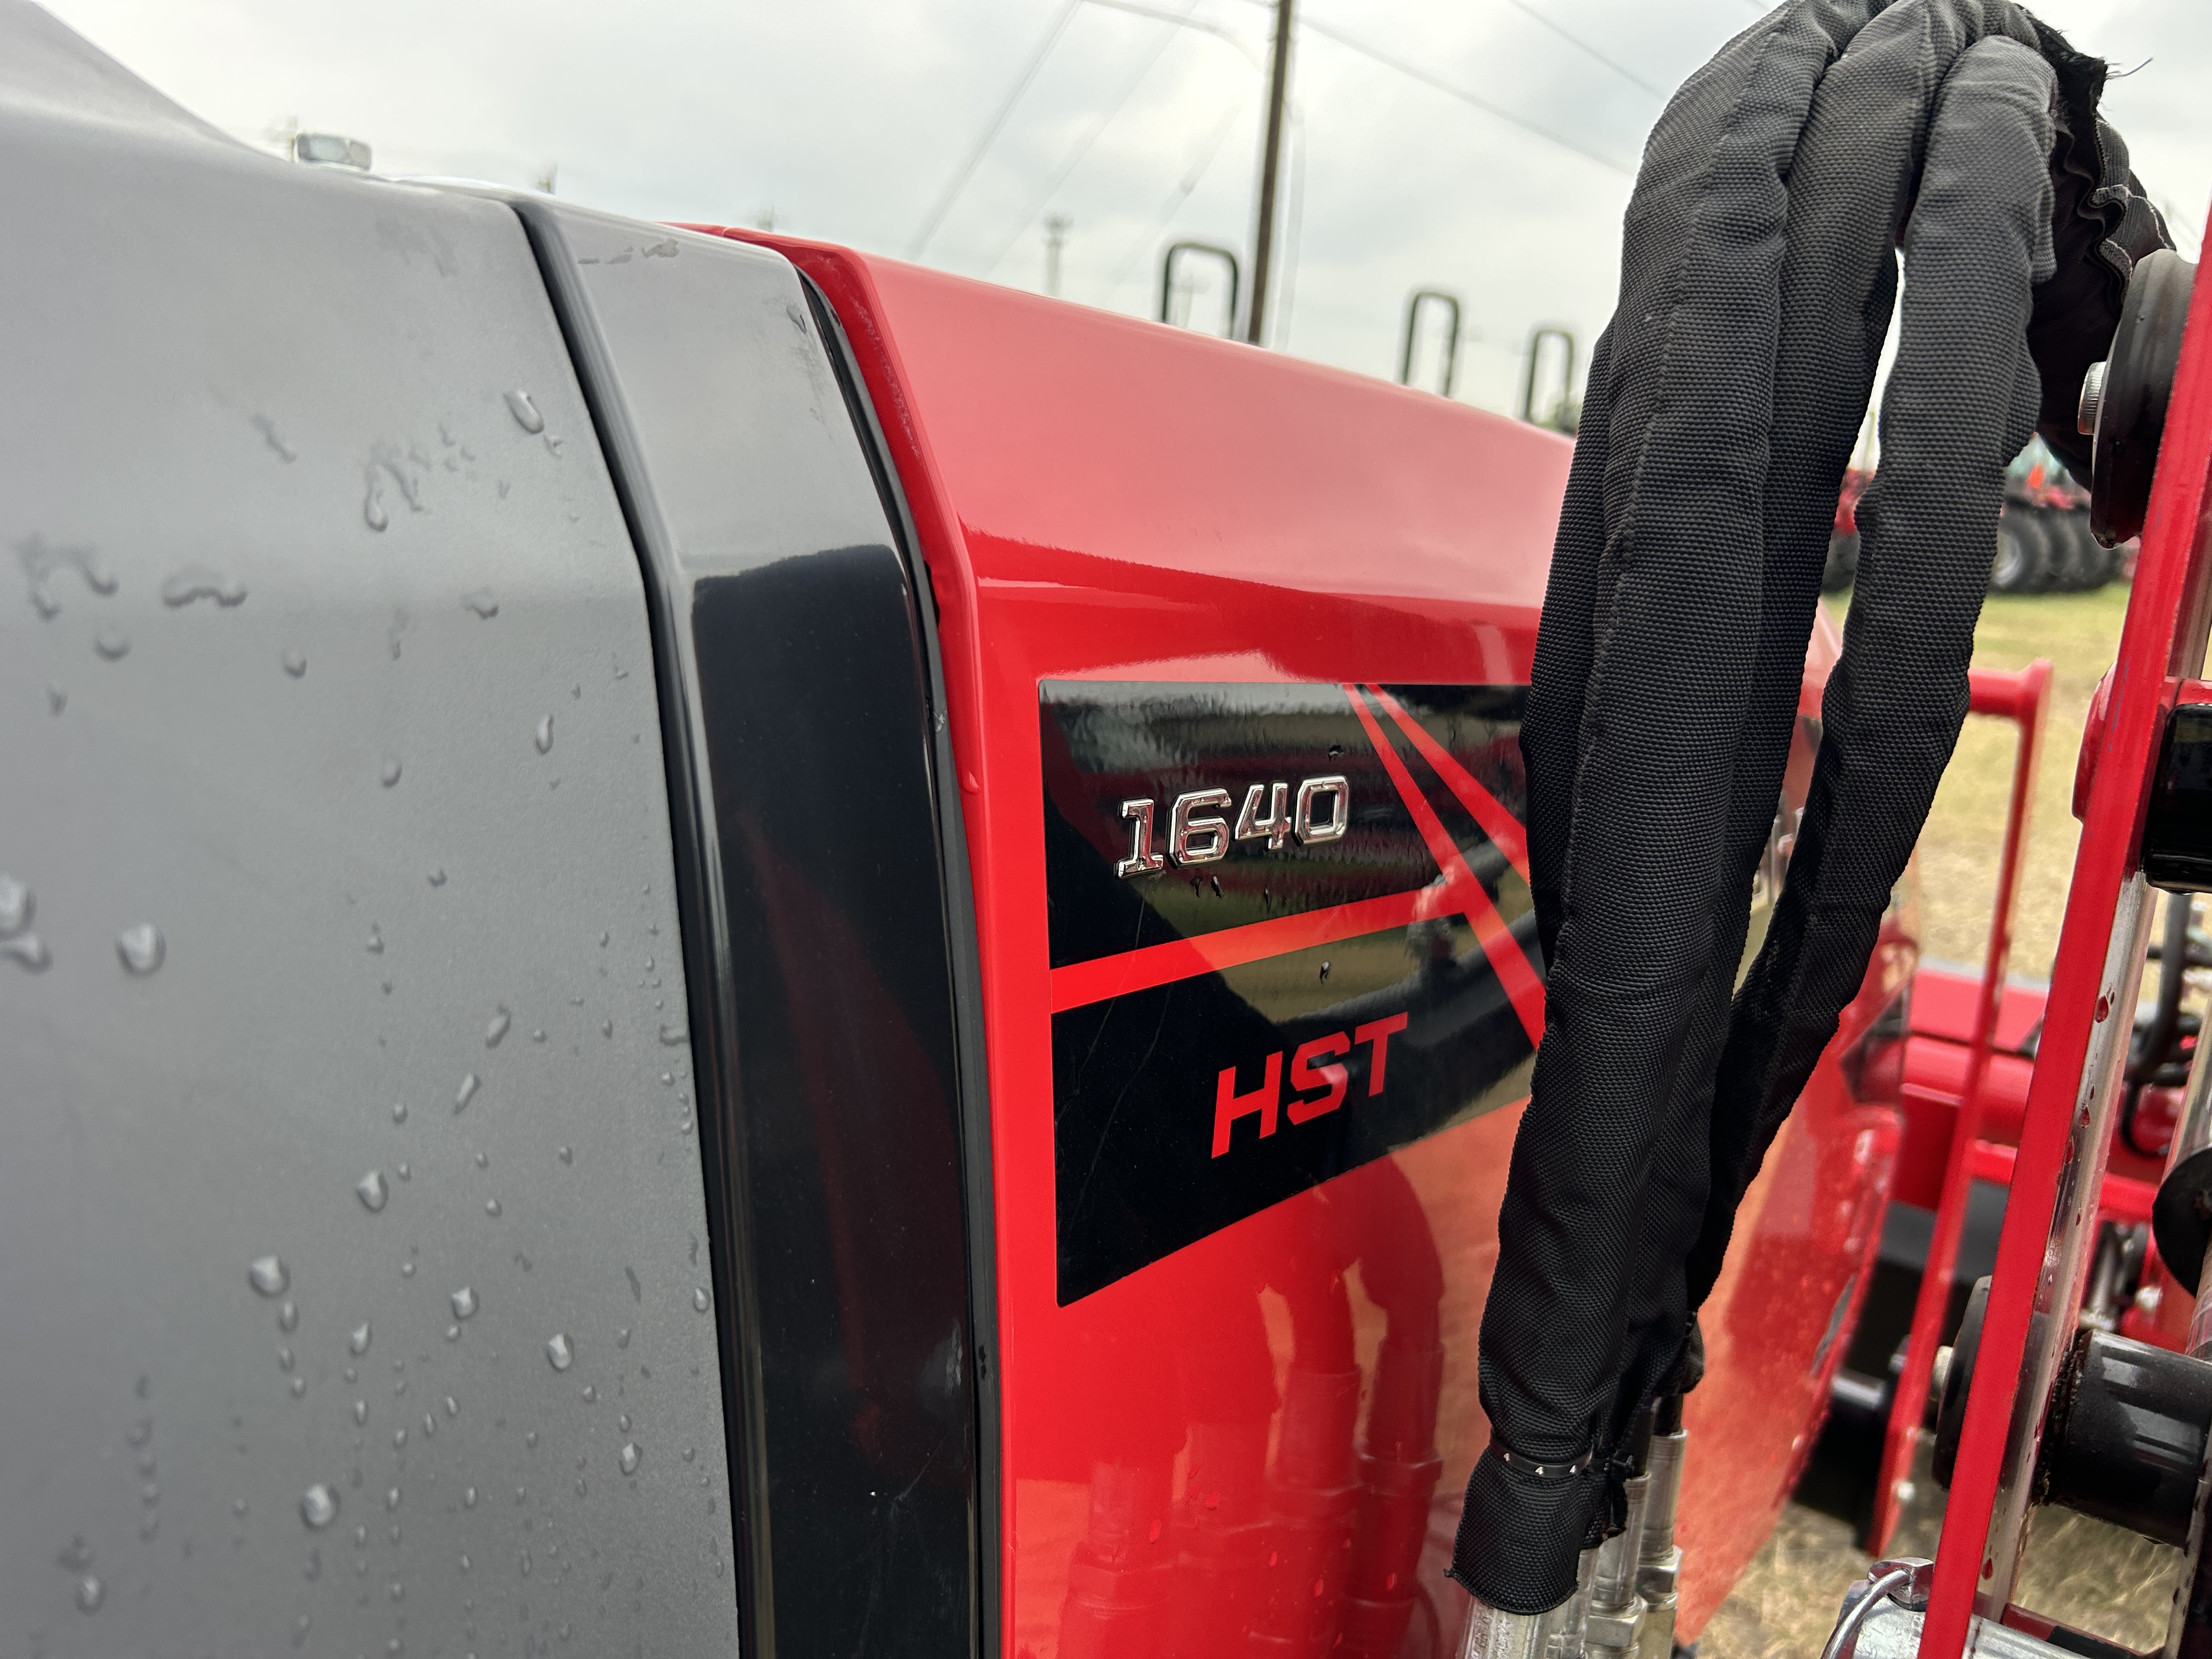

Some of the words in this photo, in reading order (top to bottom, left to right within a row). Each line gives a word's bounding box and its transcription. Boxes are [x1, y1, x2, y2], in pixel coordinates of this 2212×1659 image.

[1114, 776, 1349, 878] 1640
[1211, 1012, 1408, 1159] HST
[1535, 1465, 1543, 1475] 4
